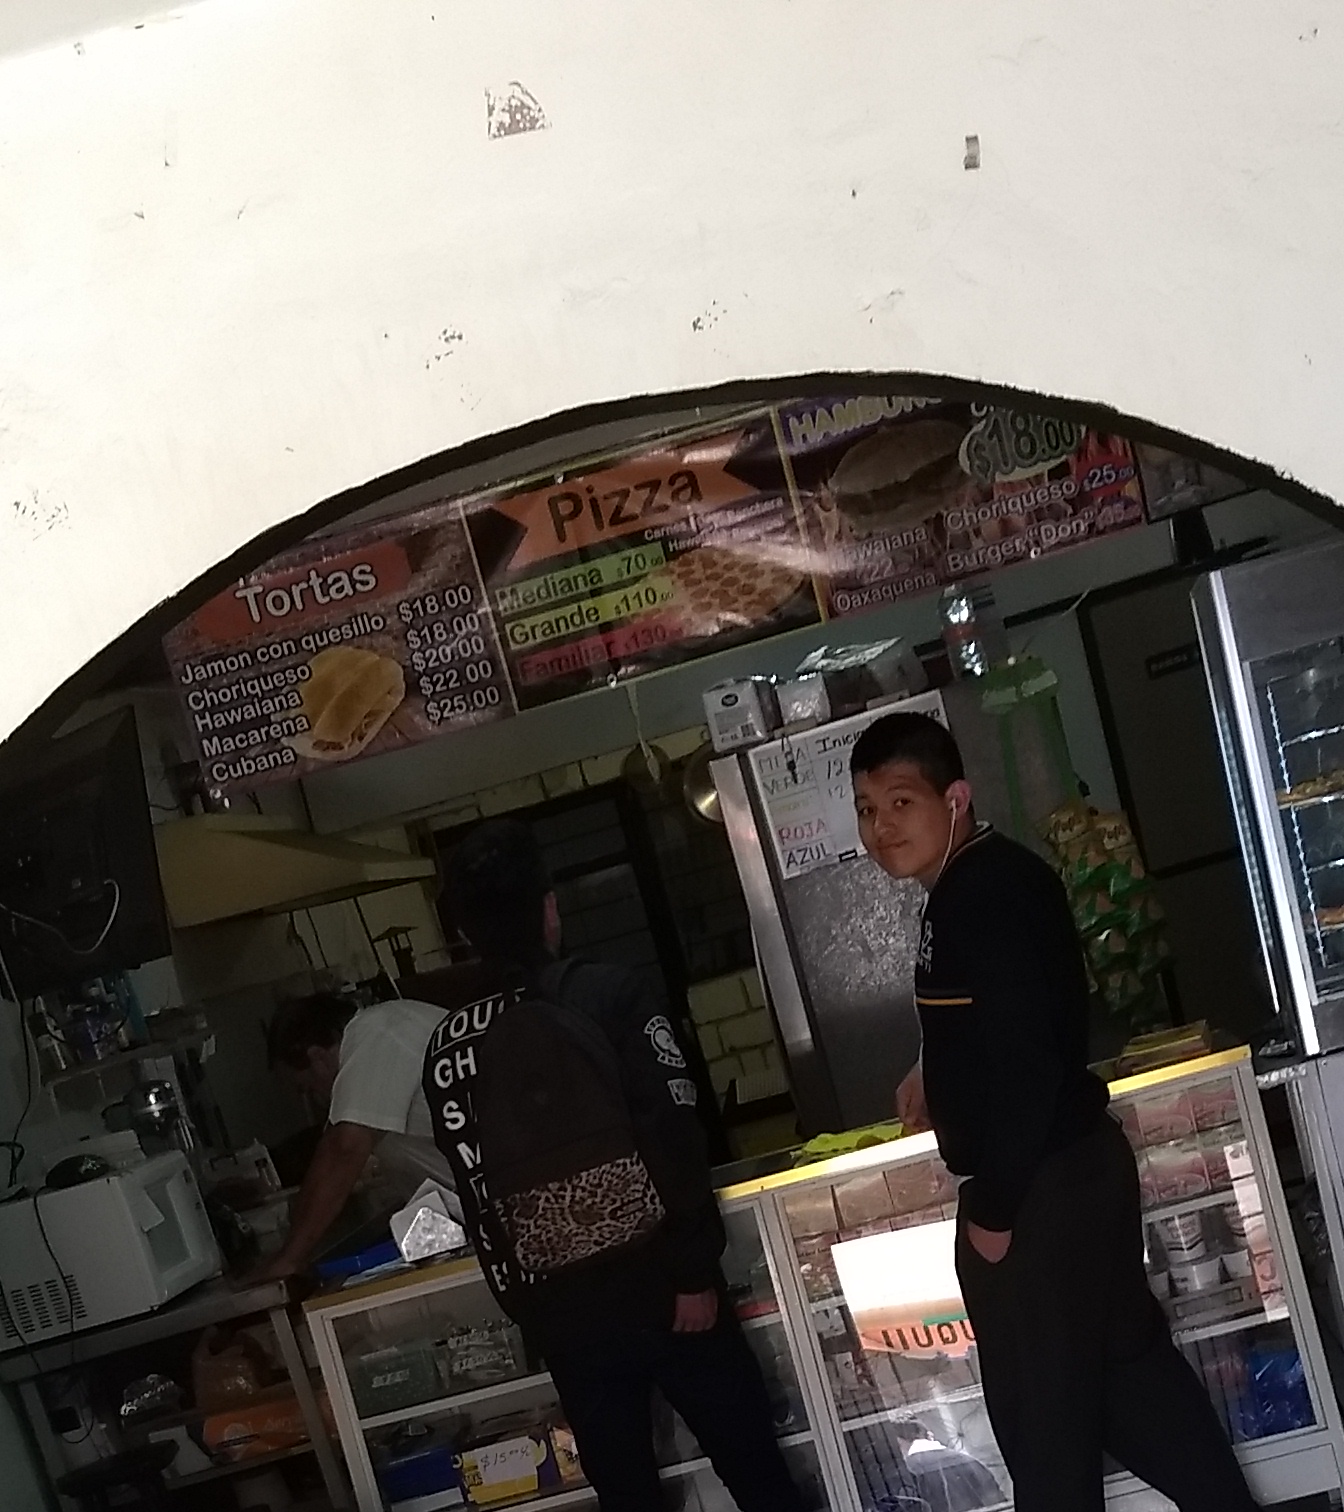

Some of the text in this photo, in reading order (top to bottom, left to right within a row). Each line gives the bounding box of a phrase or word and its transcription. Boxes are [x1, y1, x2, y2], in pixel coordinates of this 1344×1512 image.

[547, 469, 703, 544] Pizza
[944, 480, 1081, 531] Choriqueso
[948, 537, 1026, 575] Burger
[236, 562, 377, 624] Tortas
[499, 567, 604, 612] Mediana
[181, 585, 473, 685] Jamon con quesillo $18.00
[509, 605, 600, 645] Grande
[187, 613, 480, 711] Choriqueso $18.00
[194, 635, 486, 732] Hawaiana $20.00
[520, 640, 616, 678] Familiar
[201, 660, 493, 757] Macarena $22.00
[211, 686, 501, 782] Cubana $25.00
[778, 818, 828, 845] ROJA
[786, 843, 833, 869] AZUL
